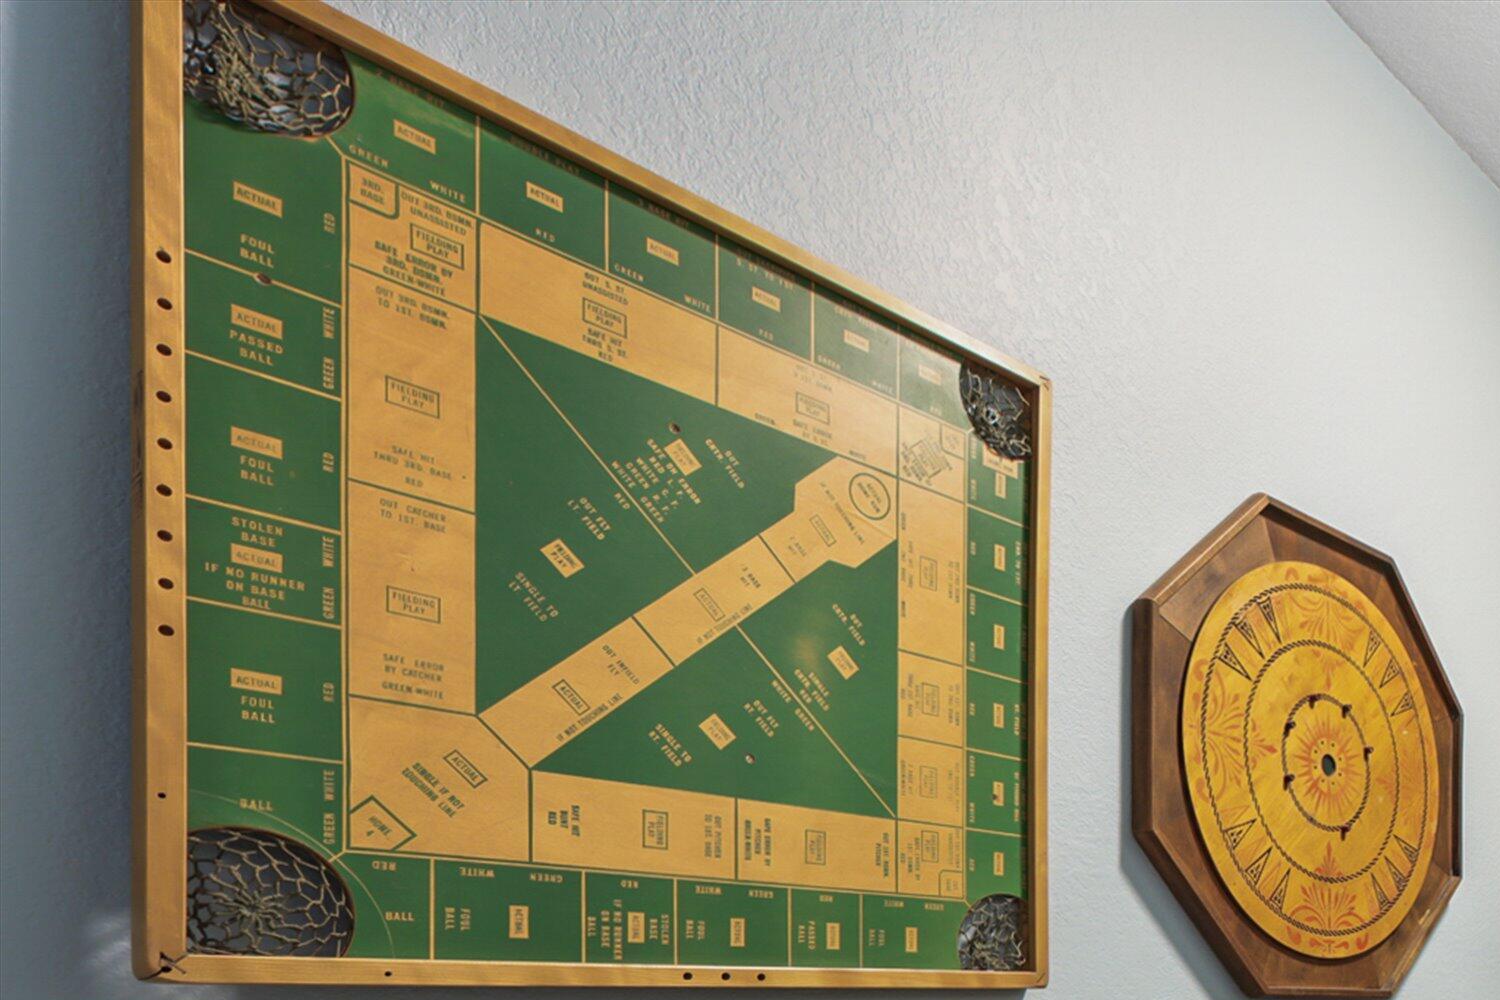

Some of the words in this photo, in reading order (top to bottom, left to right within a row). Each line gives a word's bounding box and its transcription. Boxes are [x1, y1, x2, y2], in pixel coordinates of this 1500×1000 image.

[348, 143, 389, 169] GREEN
[429, 179, 466, 204] WHITE
[236, 186, 278, 212] ACTUAL
[239, 232, 274, 255] FOUL
[535, 227, 555, 243] RED
[239, 246, 274, 269] BALL
[426, 242, 450, 260] PLAY
[236, 311, 276, 334] ACTUAL
[229, 328, 284, 356] PASSED
[239, 347, 274, 367] BALL
[390, 381, 435, 404] FIELDING
[401, 394, 424, 409] PLAY
[236, 433, 277, 453] ACTUAL
[240, 454, 274, 473] FOUL
[240, 468, 274, 487] BALL
[405, 475, 423, 488] RED
[379, 497, 398, 510] OUT
[406, 504, 446, 523] CATCHER
[614, 492, 630, 510] RED
[579, 497, 597, 515] OUT
[596, 516, 611, 532] FLY
[231, 515, 283, 537] STOLEN
[241, 530, 276, 548] BASE
[236, 549, 276, 568] ACTUAL
[322, 535, 334, 568] WHITE
[204, 561, 219, 574] IF
[225, 566, 244, 579] NO
[251, 571, 305, 591] RUNNER
[226, 579, 243, 593] ON
[251, 584, 285, 600] BASE
[515, 571, 546, 603] SINGLE
[548, 605, 559, 618] TO
[241, 595, 270, 610] BALL
[322, 586, 335, 620] GREEN
[391, 591, 436, 609] FIELDING
[402, 602, 426, 616] PLAY
[382, 652, 405, 665] SAFE
[413, 658, 444, 673] ERROR
[607, 664, 620, 676] FLY
[236, 674, 277, 690] ACTUAL
[384, 664, 396, 675] BY
[401, 667, 442, 683] CATCHER
[322, 681, 334, 703] RED
[560, 685, 584, 711] ACTUAL
[240, 695, 275, 710] FOUL
[241, 709, 275, 724] BALL
[451, 755, 480, 781] ACTUAL
[323, 769, 335, 802] WHITE
[239, 798, 272, 812] BALL
[323, 811, 335, 844] GREEN
[368, 816, 392, 836] HOME
[372, 860, 396, 871] RED
[459, 867, 495, 878] WHITE
[529, 872, 562, 883] GREEN
[620, 880, 638, 888] RED
[385, 912, 415, 921] BALL
[444, 906, 455, 930] BALL
[460, 907, 470, 931] FOUL
